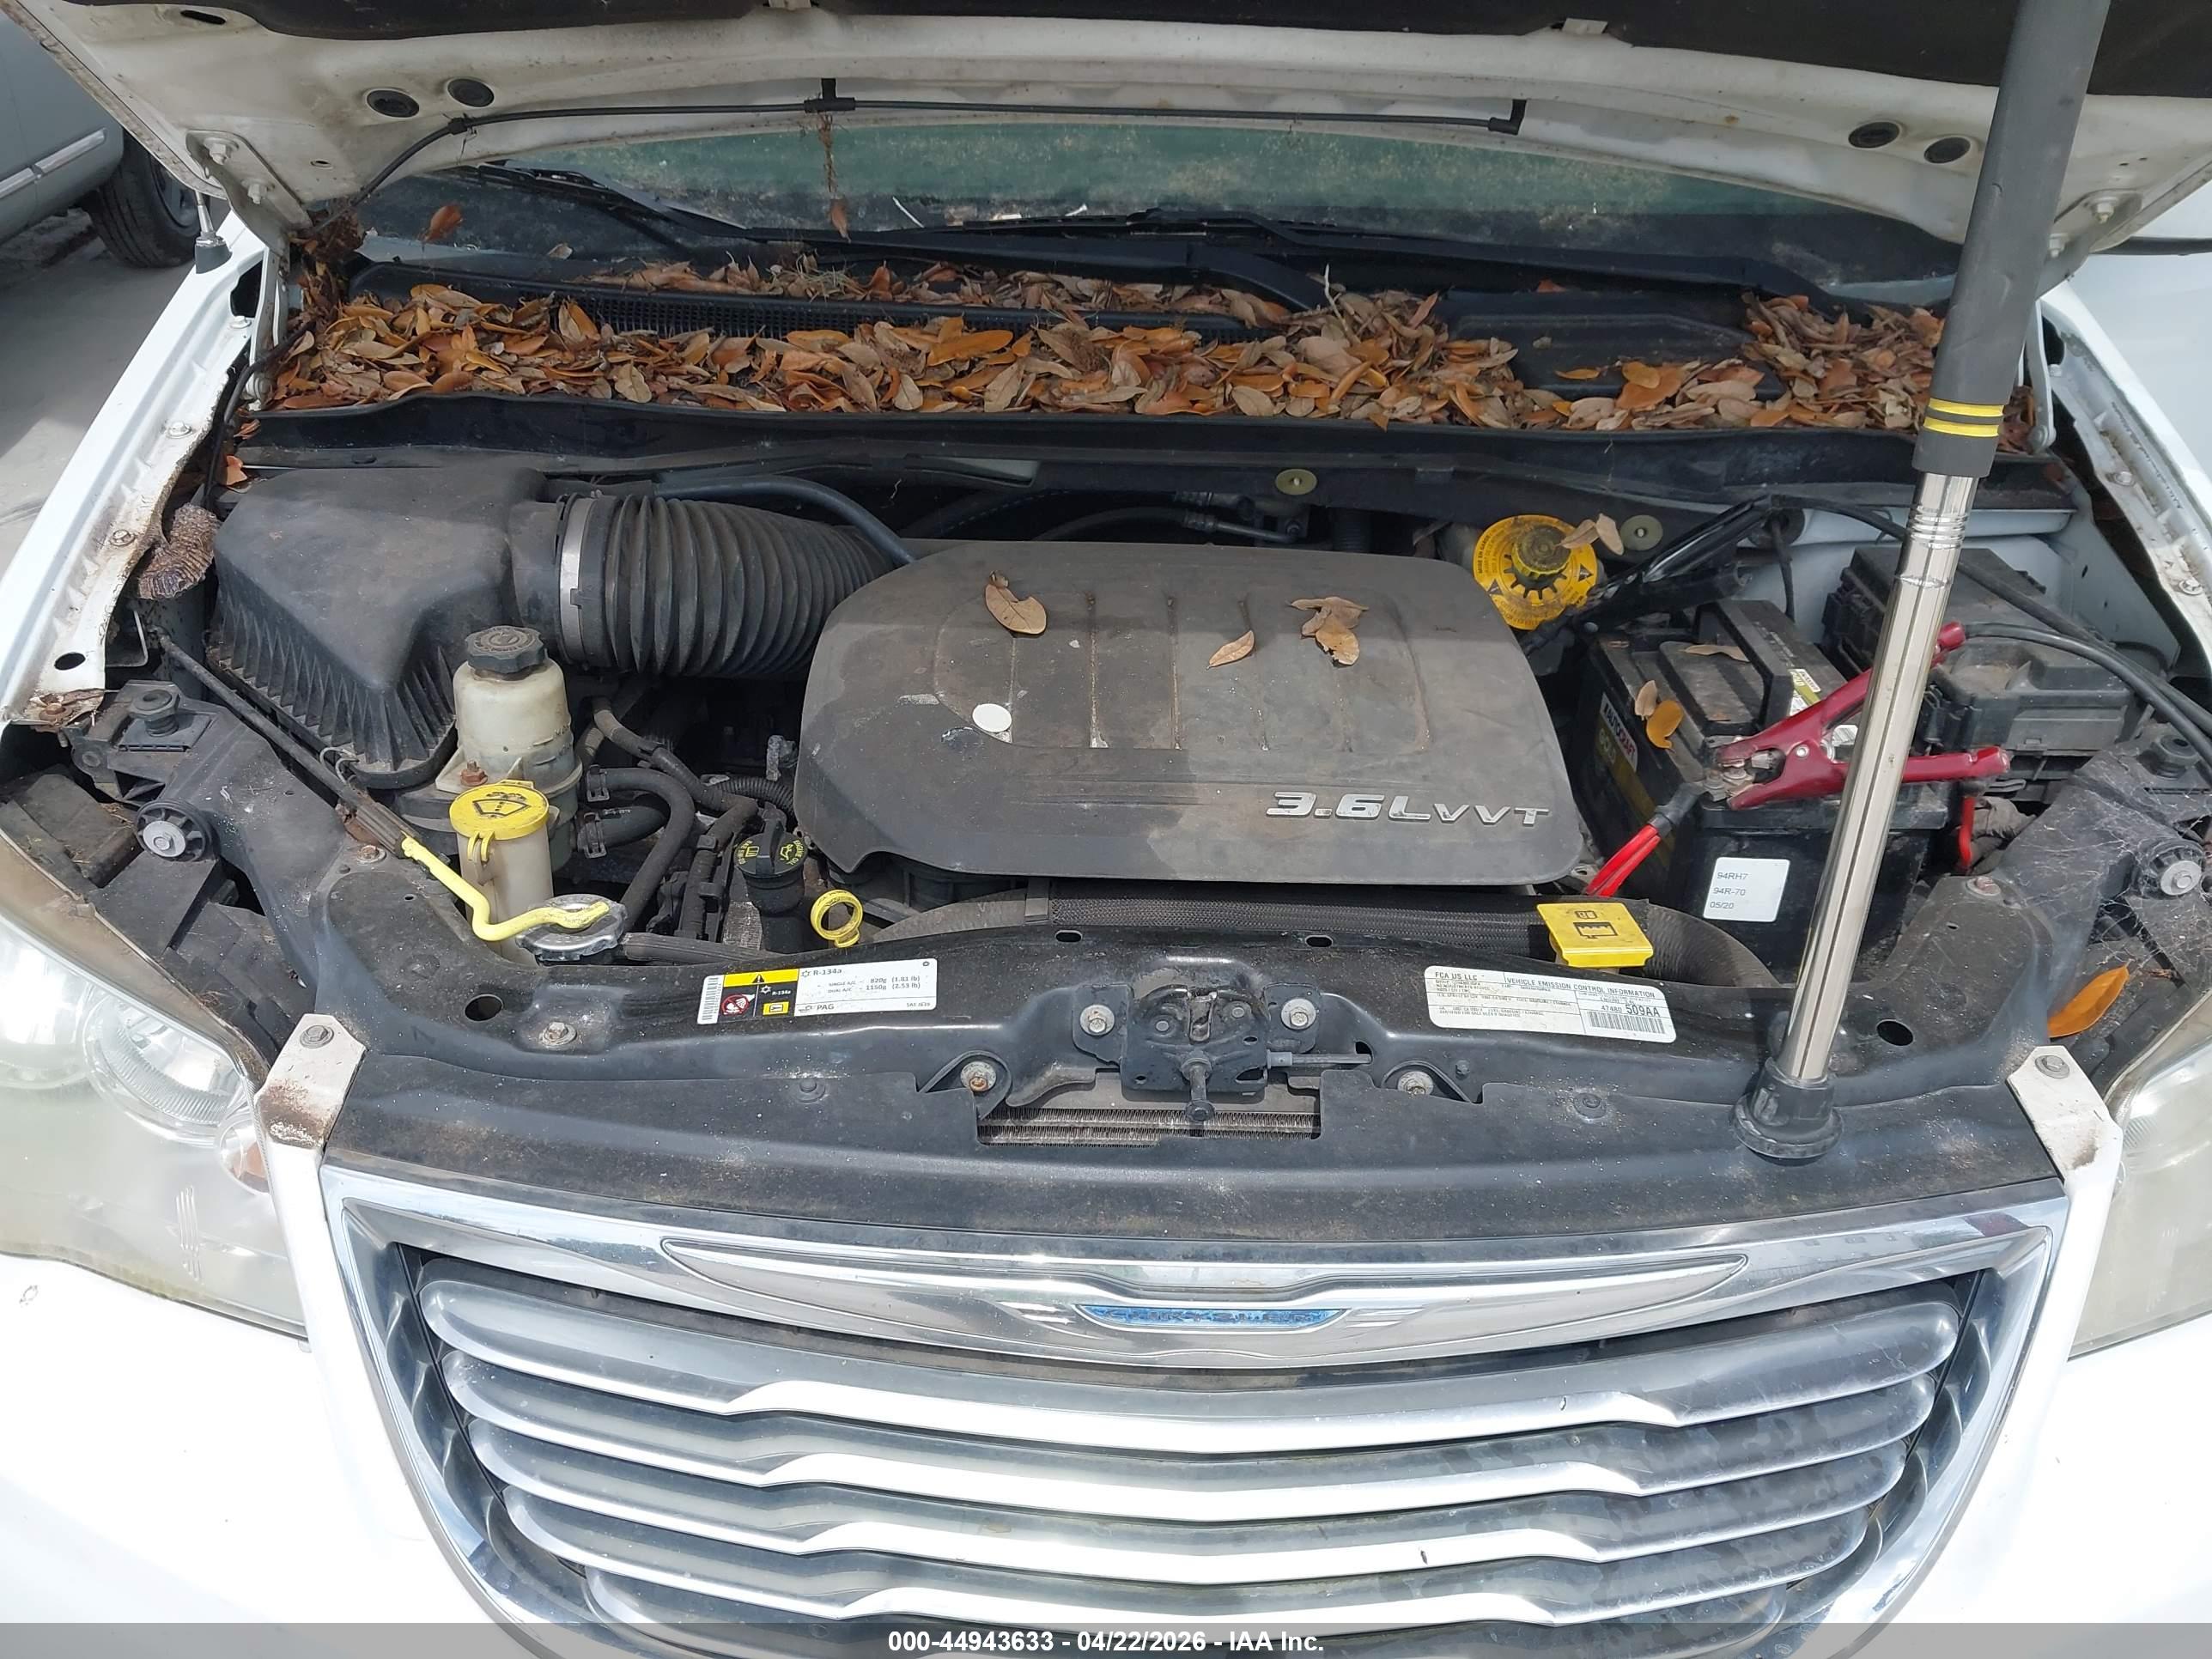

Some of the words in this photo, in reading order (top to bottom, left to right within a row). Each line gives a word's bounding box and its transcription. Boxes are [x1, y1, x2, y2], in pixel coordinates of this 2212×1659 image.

[793, 840, 804, 857] ENGINE
[786, 857, 799, 866] OIL
[1717, 872, 1748, 880] 94RH7
[1713, 887, 1746, 896] 94R-70
[1710, 901, 1735, 909] 05/20
[812, 968, 842, 976] R-134a
[1506, 977, 1536, 987] VEHICLE
[1537, 980, 1572, 990] EMISSION
[1573, 984, 1605, 994] CONTROL
[1607, 988, 1656, 999] INFORMATION
[1625, 1003, 1661, 1018] 509AA
